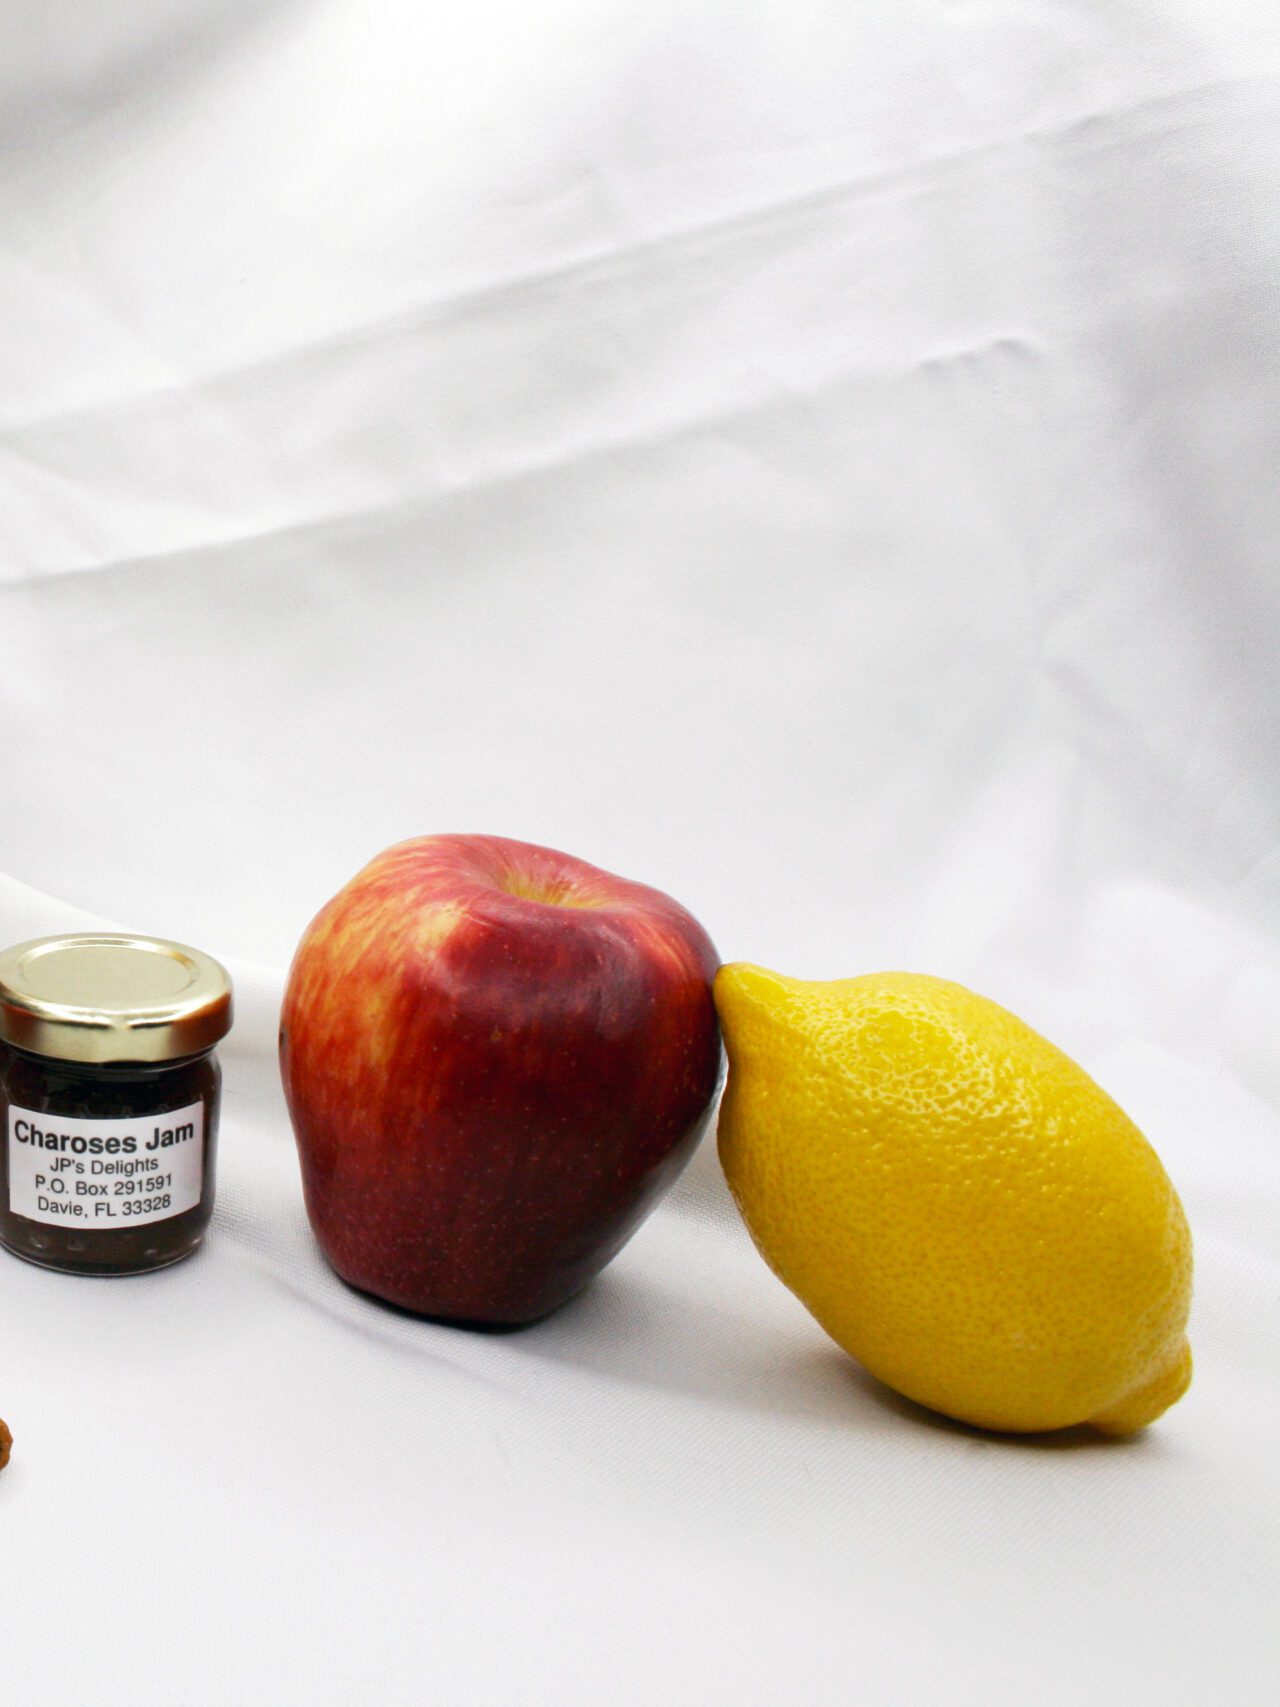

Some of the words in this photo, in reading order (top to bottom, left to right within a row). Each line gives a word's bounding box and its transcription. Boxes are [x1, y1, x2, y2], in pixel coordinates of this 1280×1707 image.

[14, 1119, 137, 1155] Charoses
[146, 1122, 194, 1151] Jam
[50, 1157, 85, 1174] JP's
[91, 1157, 159, 1177] Delights
[35, 1174, 69, 1194] P.O.
[76, 1182, 108, 1196] Box
[114, 1173, 172, 1195] 291591
[38, 1196, 88, 1218] Davie,
[94, 1203, 116, 1217] FL
[122, 1194, 171, 1216] 33328
